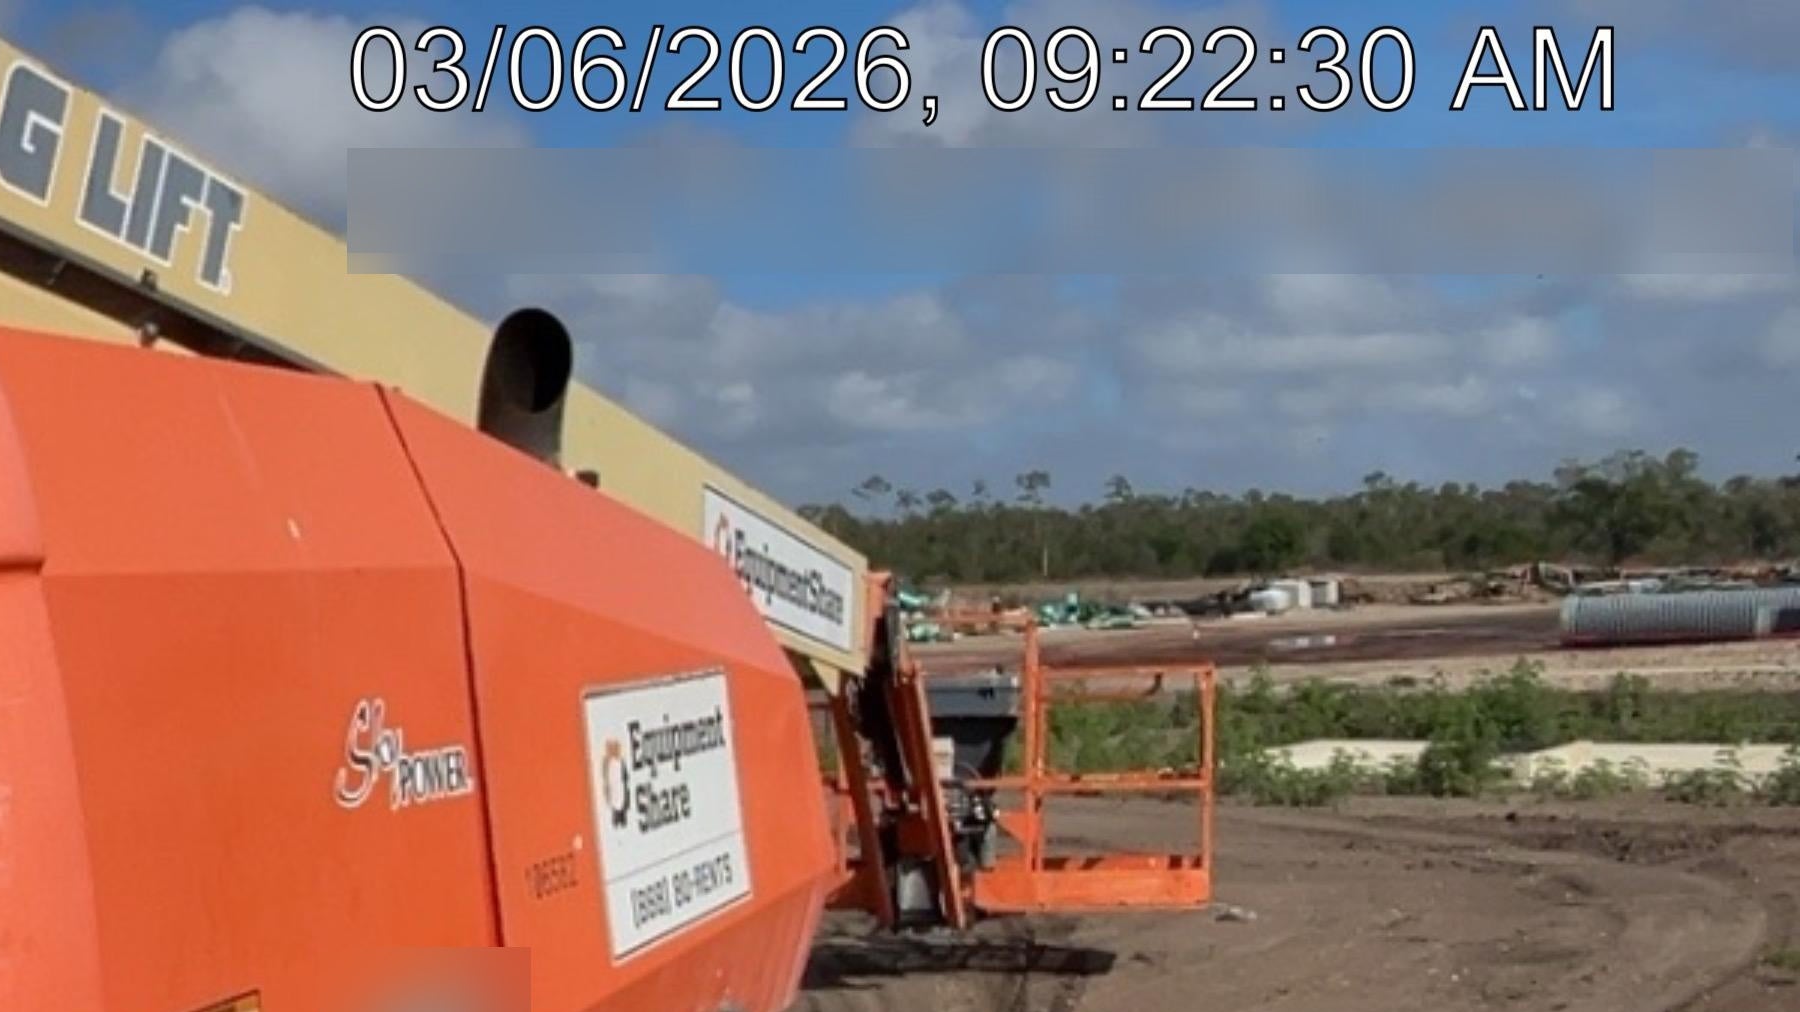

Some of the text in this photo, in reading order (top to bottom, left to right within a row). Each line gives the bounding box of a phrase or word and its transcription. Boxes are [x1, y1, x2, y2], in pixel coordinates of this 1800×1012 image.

[75, 106, 249, 295] LIFT
[734, 529, 843, 626] EquipmentShare
[626, 705, 726, 778] Equipment
[634, 780, 691, 834] Share
[672, 852, 733, 907] 80-RENTS
